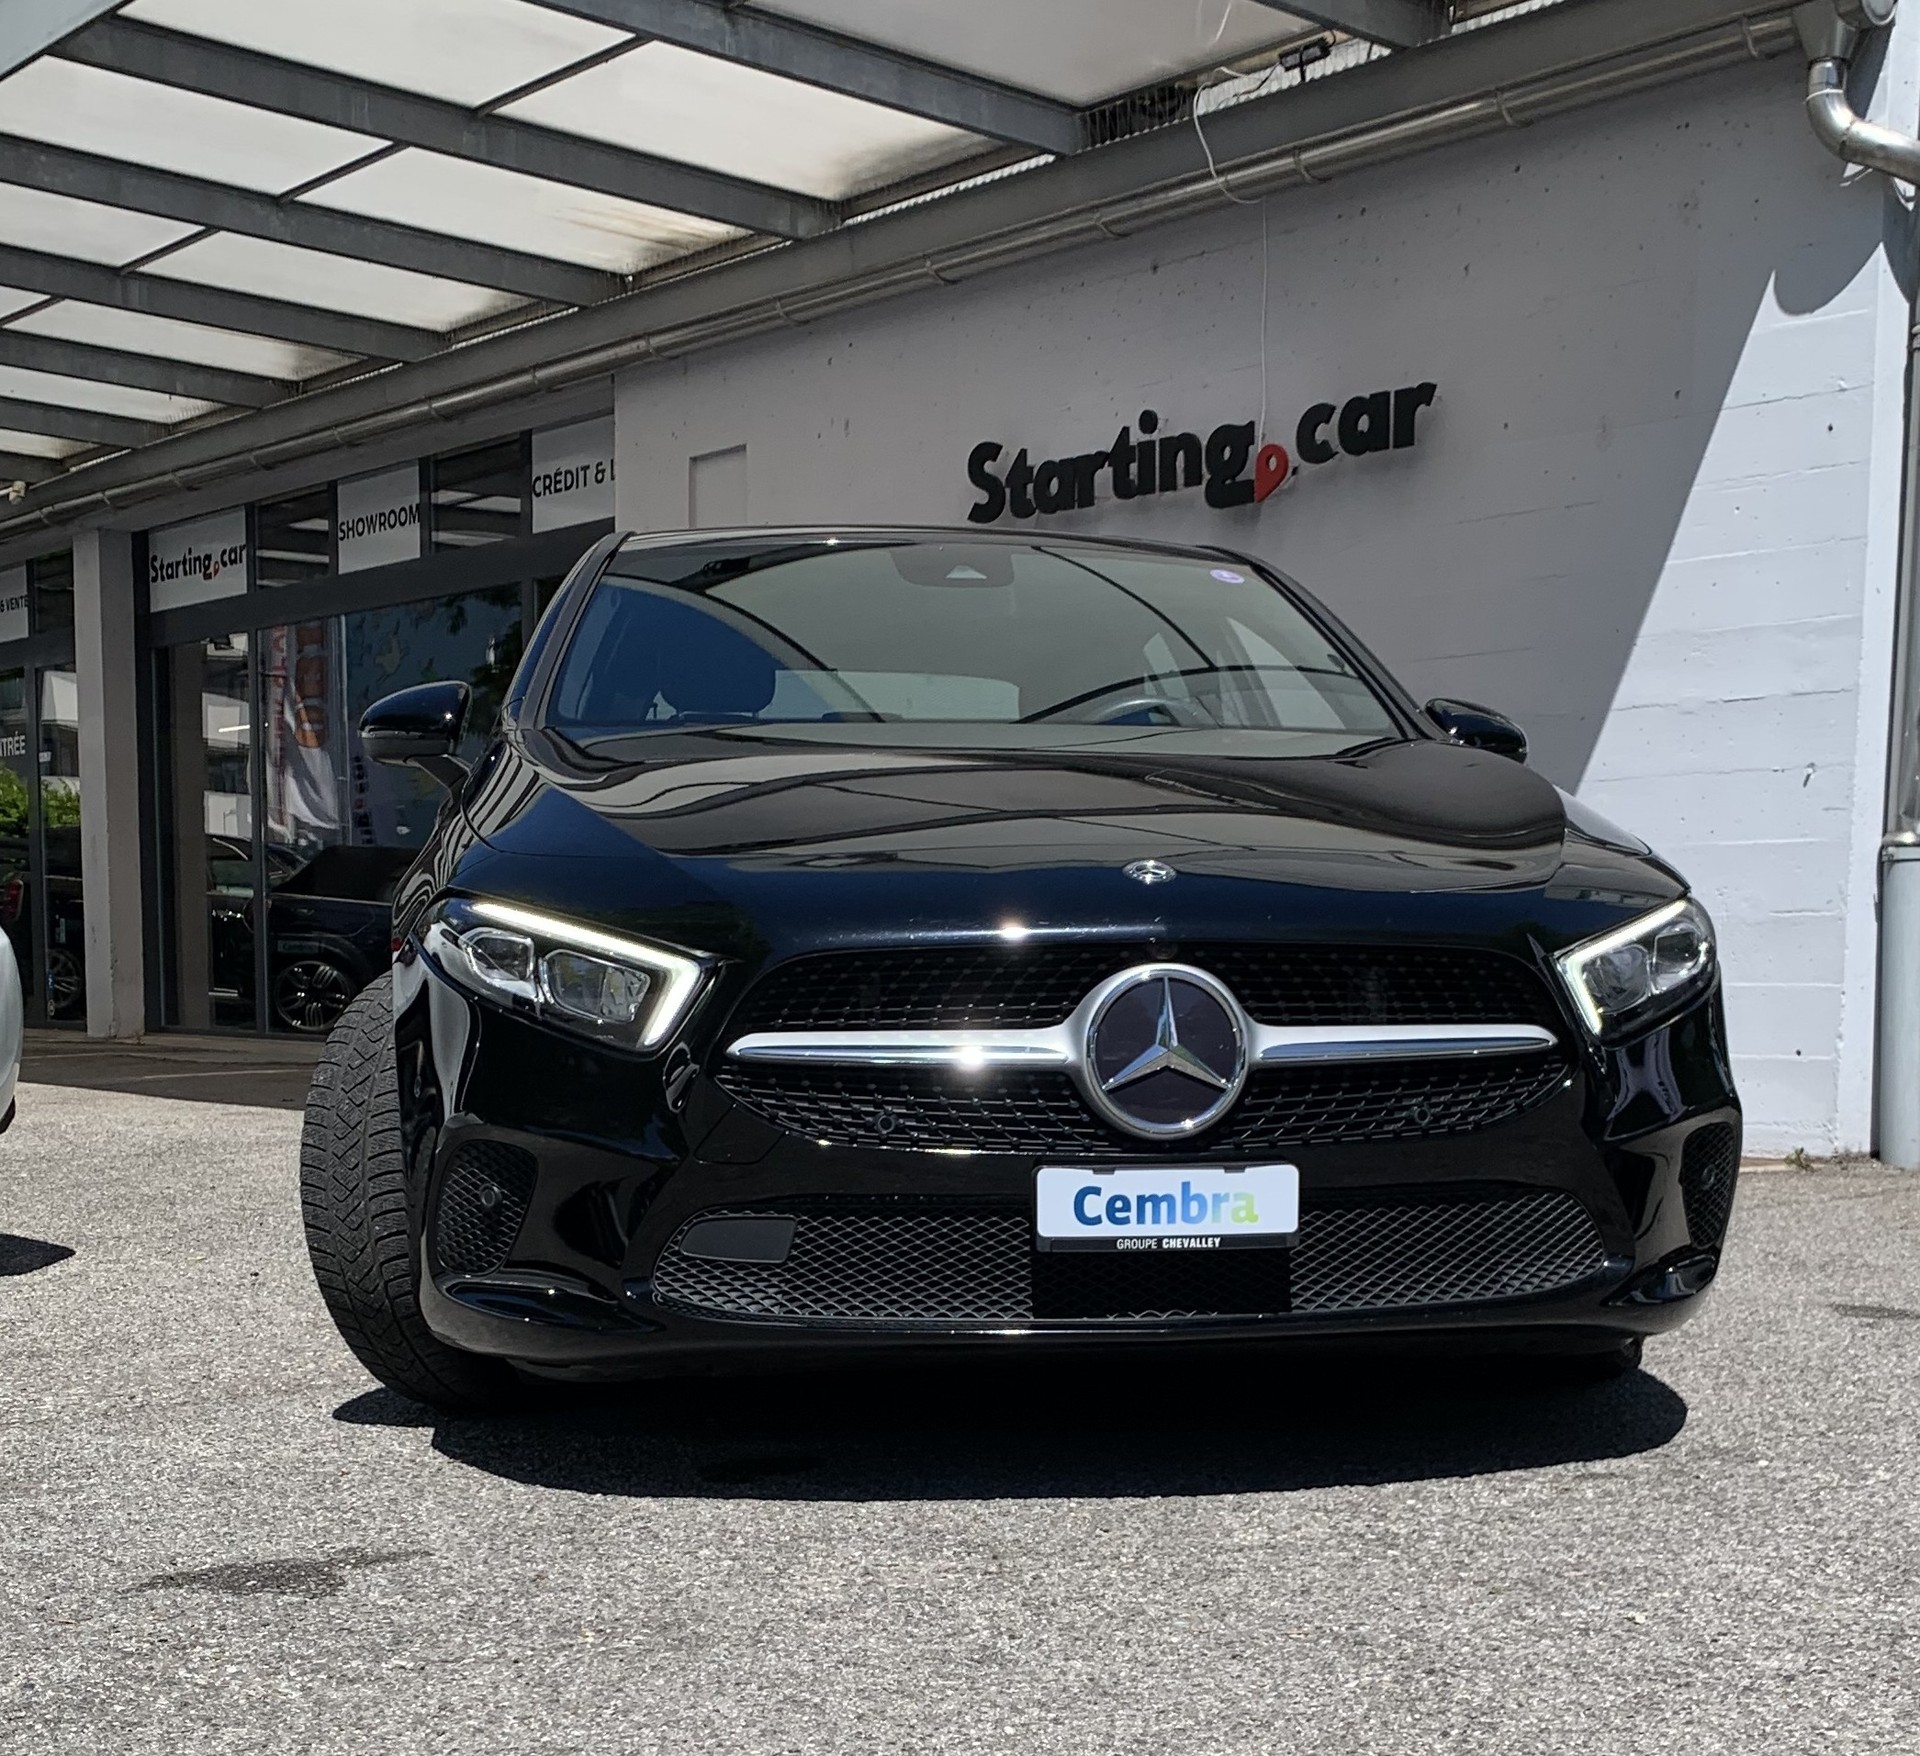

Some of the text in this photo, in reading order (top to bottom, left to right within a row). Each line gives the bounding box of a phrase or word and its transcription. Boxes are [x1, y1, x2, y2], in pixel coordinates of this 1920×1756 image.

[532, 464, 590, 498] CRÉDIT
[594, 461, 606, 484] &
[339, 503, 421, 541] SHOWROOM
[6, 595, 29, 611] VENTE
[1073, 1181, 1259, 1226] Cembra
[1116, 1237, 1221, 1250] GROUPE CHEVALLEY
